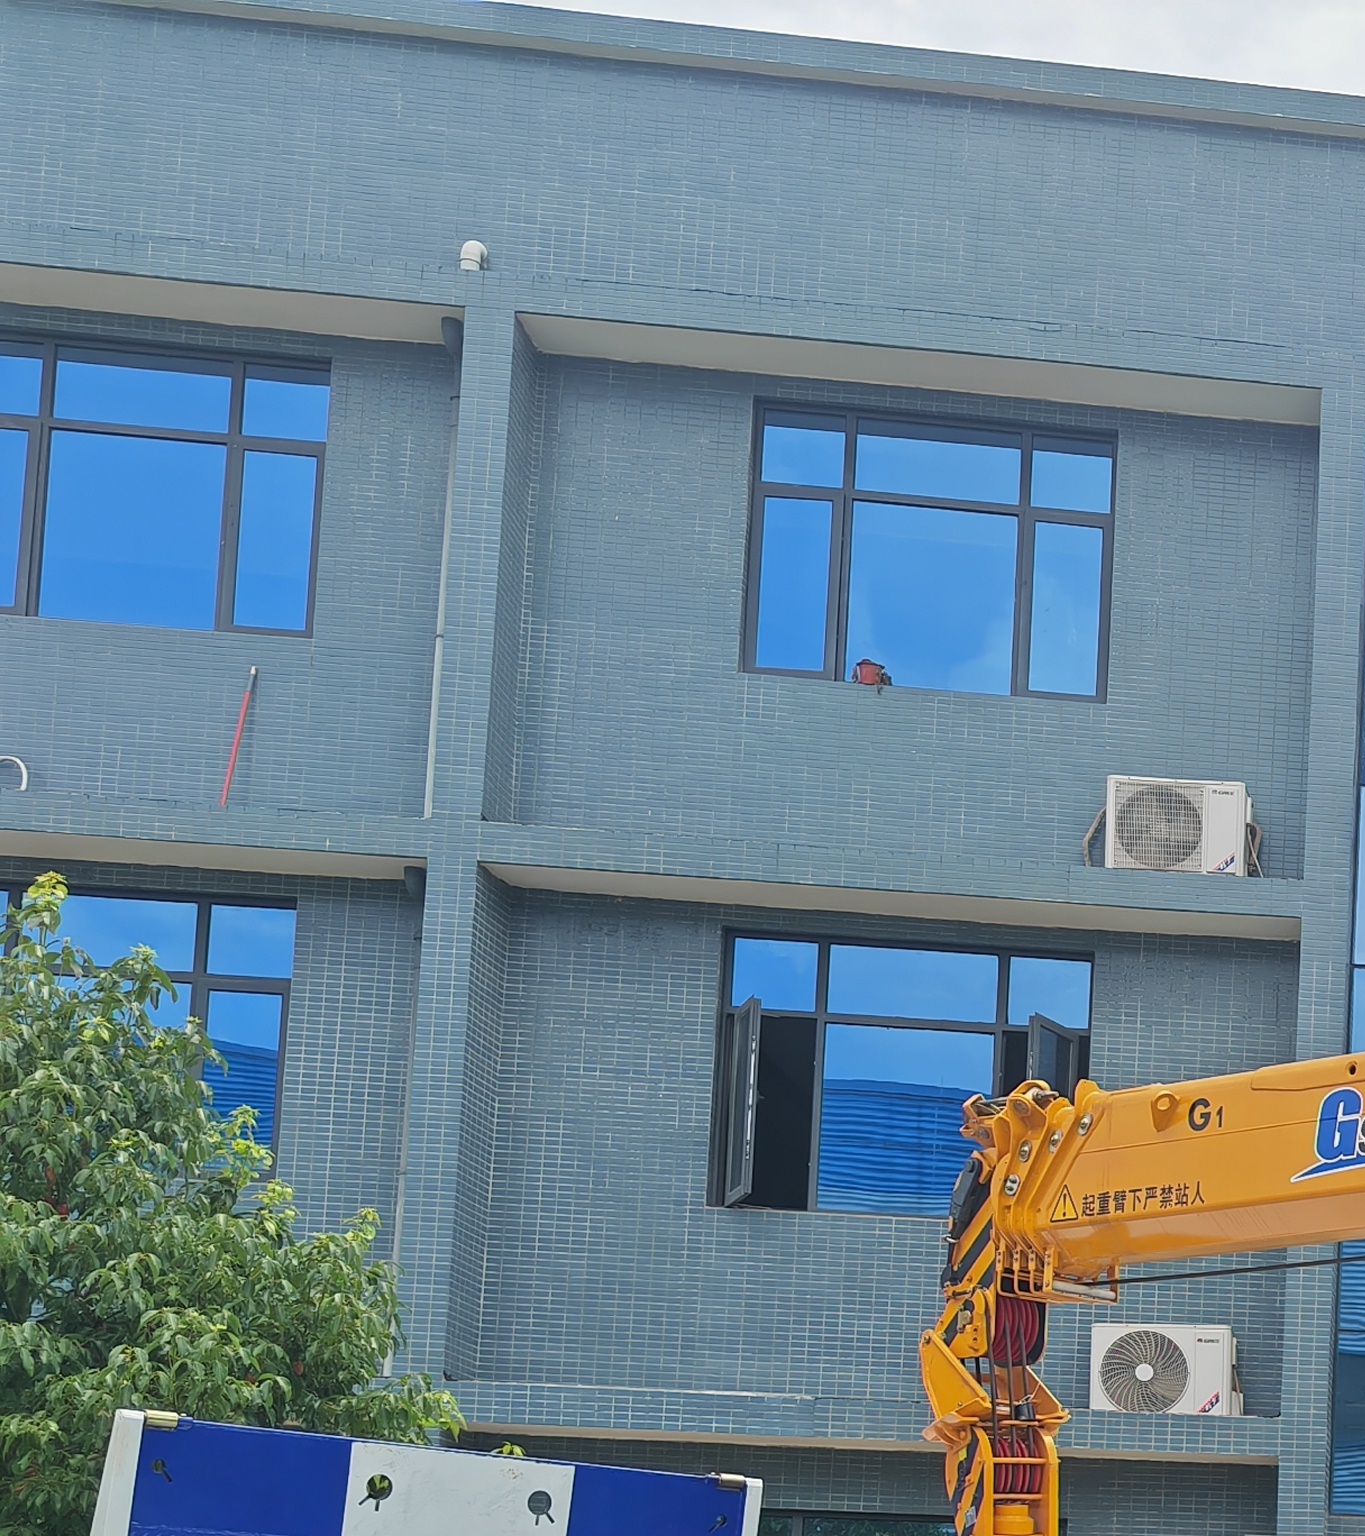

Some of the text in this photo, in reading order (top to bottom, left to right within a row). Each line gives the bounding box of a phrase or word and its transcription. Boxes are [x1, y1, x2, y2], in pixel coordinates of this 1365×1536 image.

[1081, 1181, 1205, 1217] 起重臂下严禁站人
